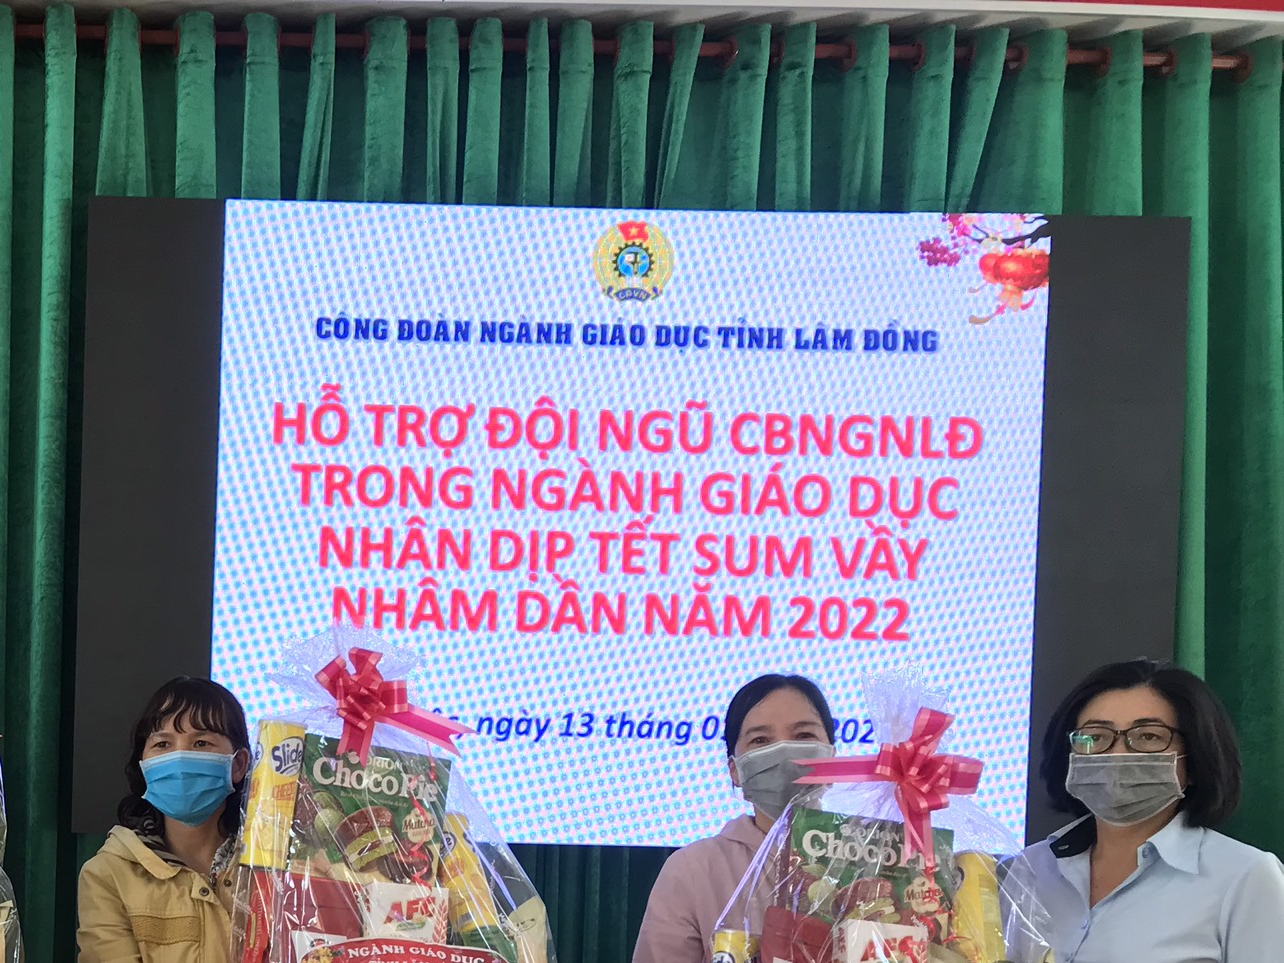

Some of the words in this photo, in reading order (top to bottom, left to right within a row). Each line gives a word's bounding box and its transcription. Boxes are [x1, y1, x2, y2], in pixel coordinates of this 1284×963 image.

[316, 312, 388, 340] CÔNG
[397, 313, 470, 342] ĐOÀN
[480, 315, 573, 345] NGÀNH
[582, 317, 646, 346] GIÁO
[655, 324, 709, 353] DỤC
[717, 317, 784, 349] TỈNH
[795, 322, 854, 351] LÂM
[863, 319, 939, 352] ĐỒNG
[273, 383, 350, 446] HỖ
[364, 403, 476, 458] TRỢ
[485, 396, 579, 461] ĐỘI
[599, 400, 713, 456] NGŨ
[730, 412, 984, 459] CBNGNLĐ
[291, 464, 473, 510] TRONG
[492, 457, 683, 514] NGÀNH
[700, 462, 832, 518] GIÁO
[849, 476, 960, 528] DỤC
[319, 515, 471, 571] NHÂN
[489, 529, 575, 583] DỊP
[589, 514, 681, 575] TẾT
[693, 533, 813, 578] SUM
[831, 519, 929, 580] VẦY
[332, 576, 498, 632] NHÂM
[516, 574, 627, 634] DẦN
[644, 581, 772, 638] NĂM
[788, 596, 911, 641] 2022
[477, 713, 550, 744] ngày
[559, 713, 593, 737] 13
[605, 712, 691, 745] tháng
[347, 943, 405, 958] NGÀNH
[408, 946, 447, 960] GIÁO
